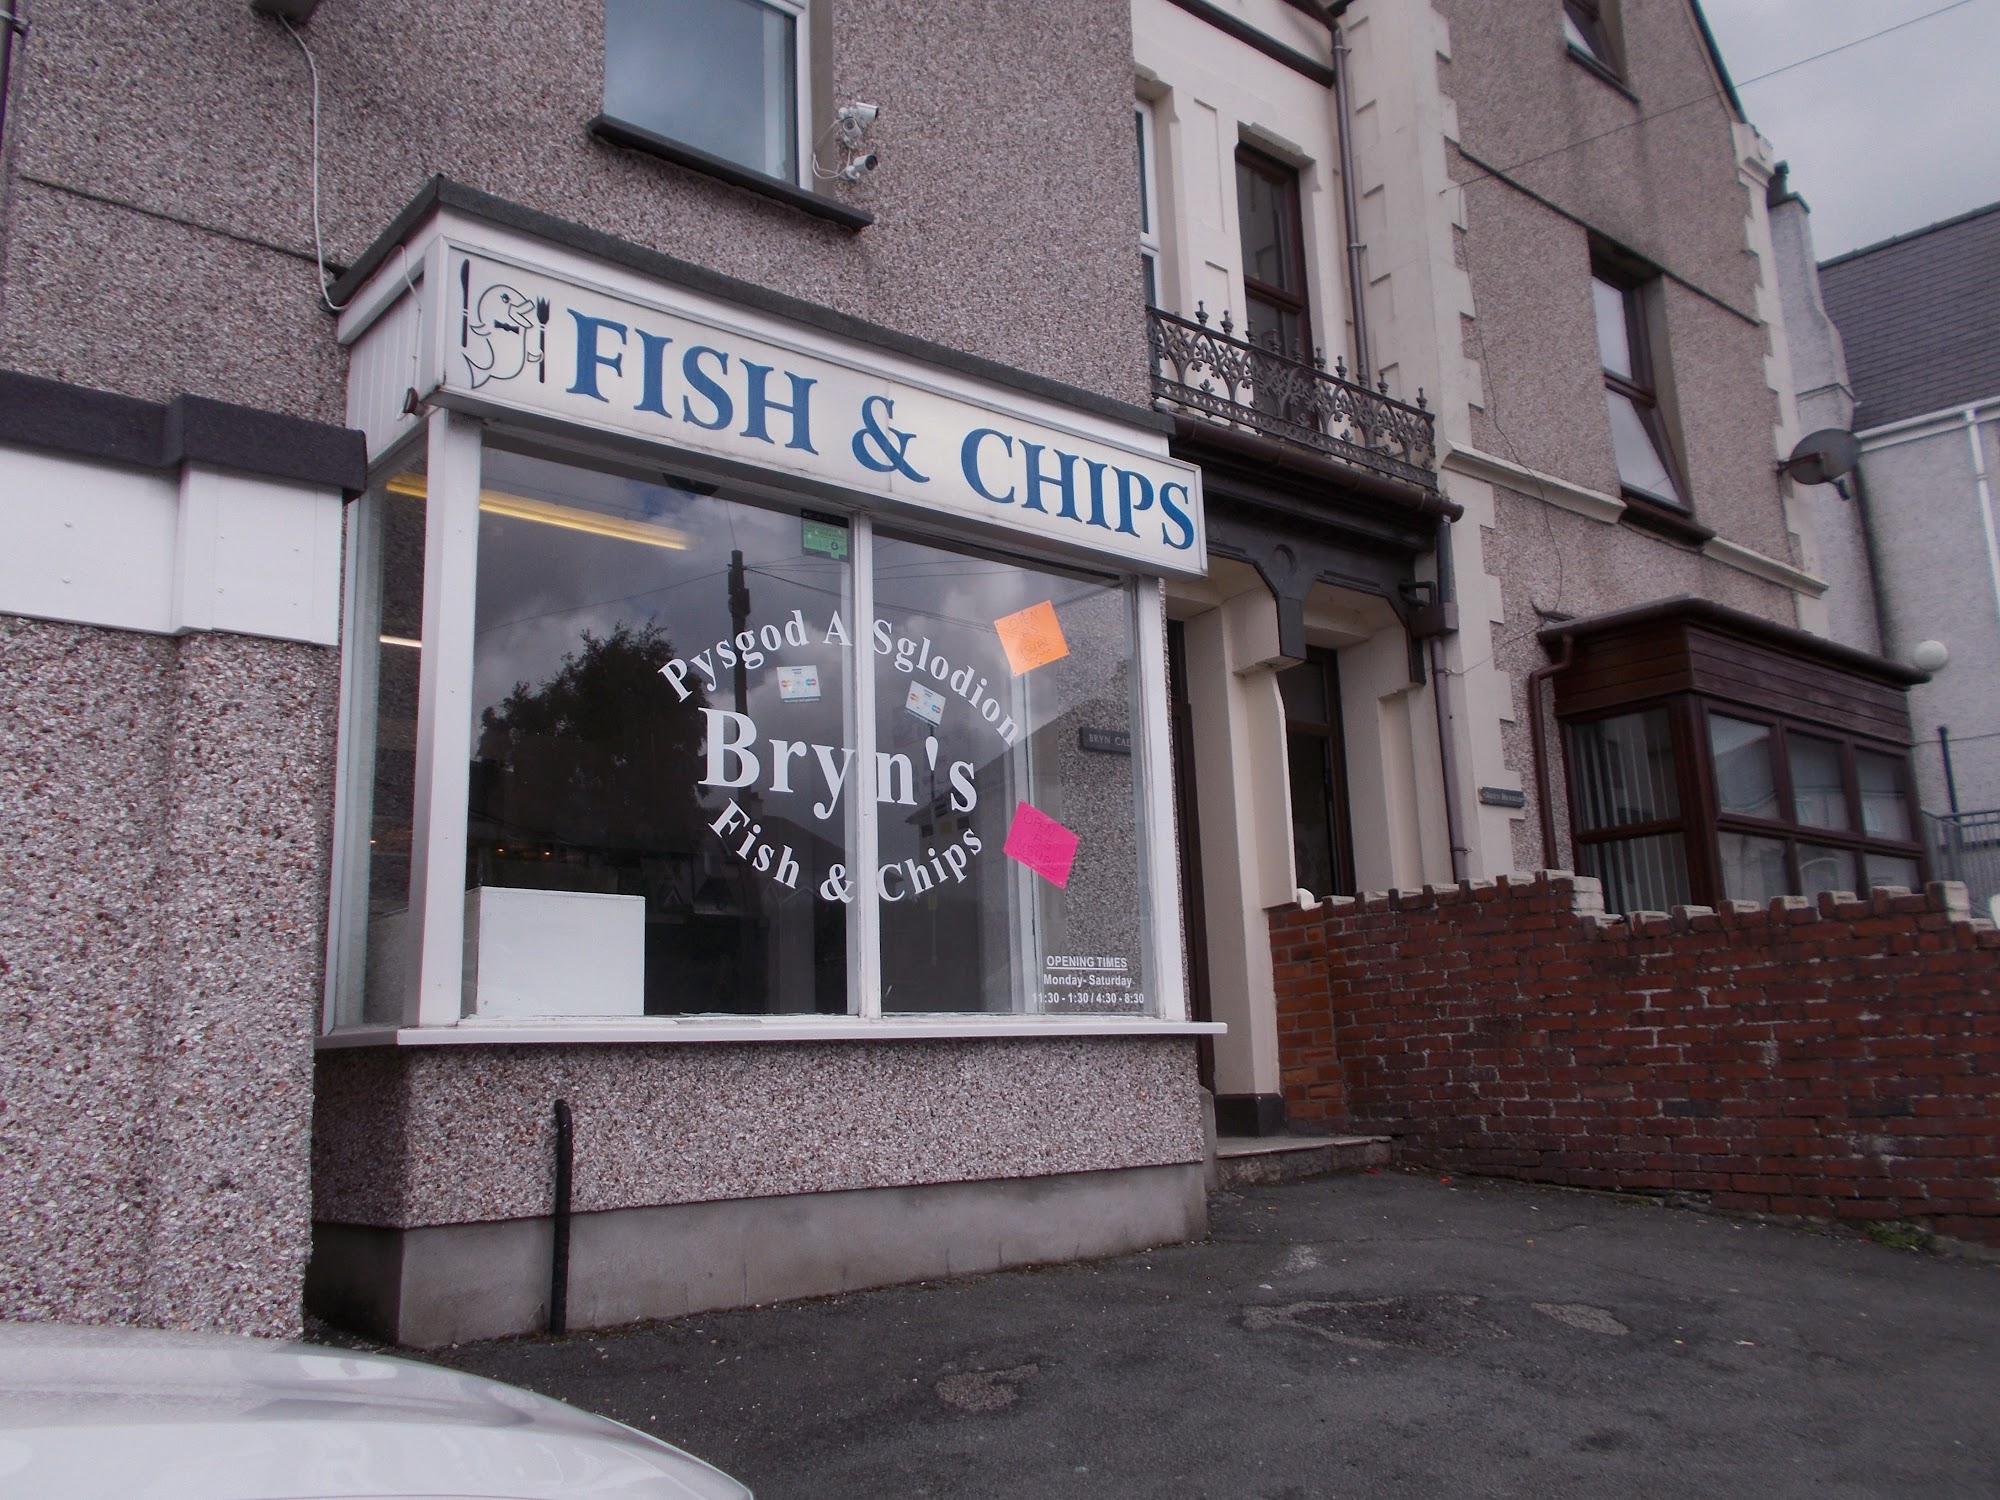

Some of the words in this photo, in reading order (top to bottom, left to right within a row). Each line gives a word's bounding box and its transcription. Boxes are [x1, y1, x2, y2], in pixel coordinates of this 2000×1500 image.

[565, 308, 819, 456] FISH
[852, 395, 931, 483] &
[960, 428, 1195, 550] CHIPS
[657, 609, 810, 703] Pysgod
[822, 609, 853, 647] A
[873, 619, 1019, 746] Sglodion
[1089, 733, 1111, 744] BRYN
[698, 707, 977, 819] Bryn's
[1023, 812, 1056, 838] OPEN
[708, 798, 800, 889] Fish
[820, 863, 855, 903] &
[876, 828, 982, 901] Chips
[1046, 955, 1095, 968] OPENING
[1096, 957, 1128, 968] TIMES
[1089, 974, 1133, 988] Saturday
[1032, 992, 1060, 1004] 11:30
[1068, 992, 1089, 1004] 1:30
[1096, 993, 1117, 1004] 4:30
[1124, 993, 1145, 1004] 8:30
